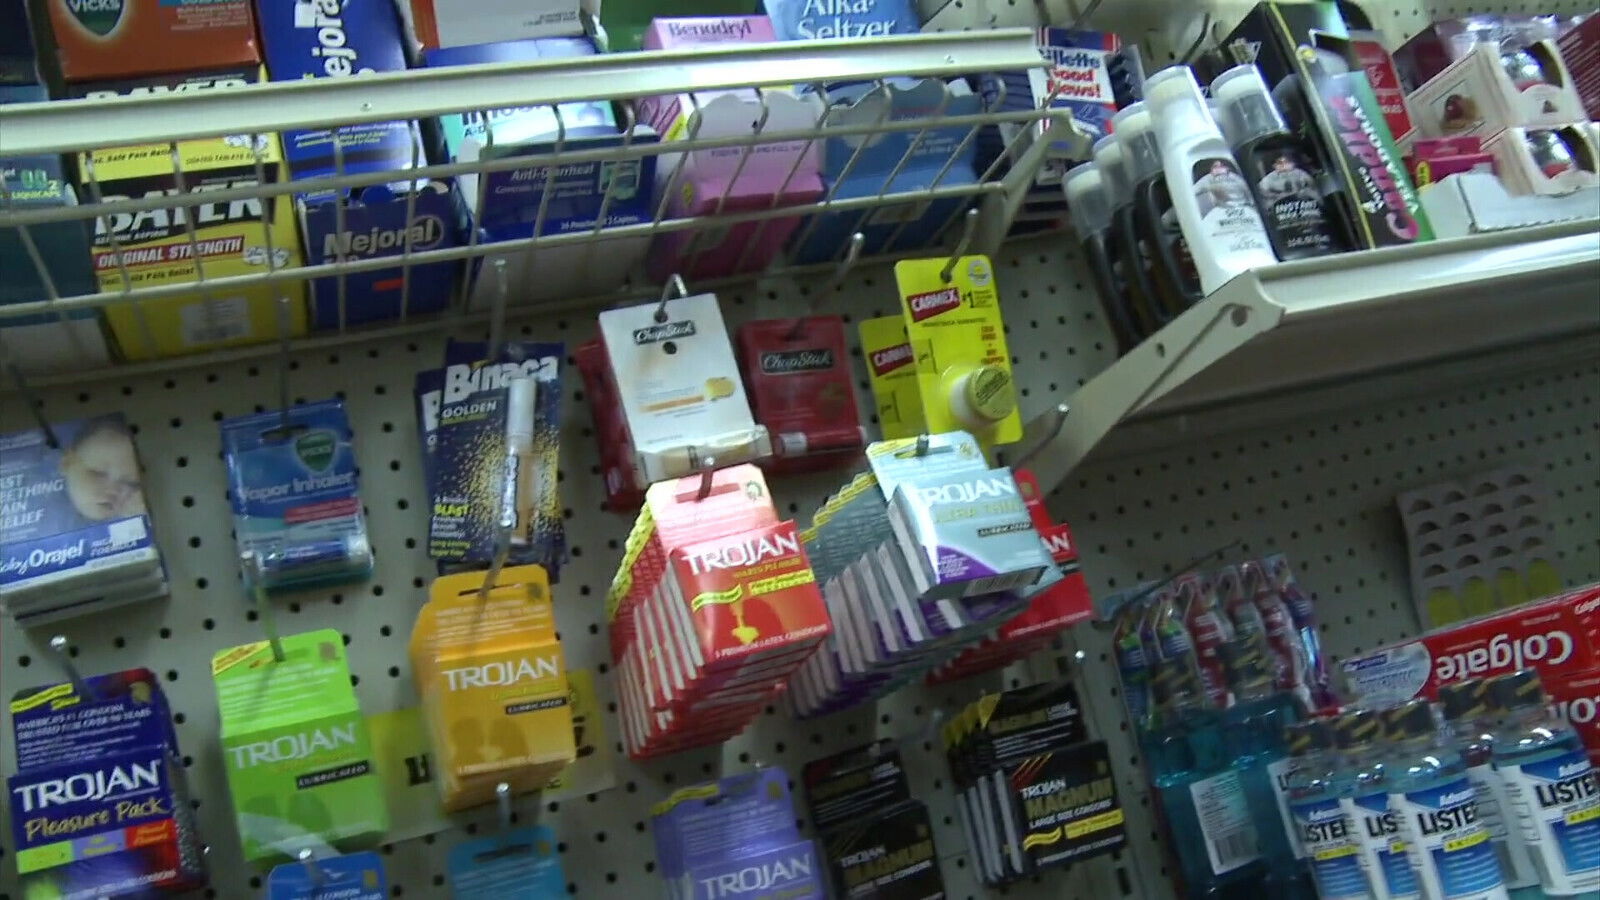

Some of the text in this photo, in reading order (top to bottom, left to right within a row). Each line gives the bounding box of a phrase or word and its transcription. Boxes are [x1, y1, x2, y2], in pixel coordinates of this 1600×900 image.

[311, 0, 357, 77] ejora
[669, 19, 753, 38] Benadryl
[798, 18, 897, 40] Seltzer
[511, 163, 595, 181] Anti-Drrheal
[95, 181, 264, 236] BAYER
[321, 213, 438, 255] Mejoral
[98, 236, 243, 268] ORIGINAL STRENGTH
[636, 323, 694, 343] ChapStick
[764, 354, 831, 371] ChapStick
[444, 356, 558, 404] Binaca
[441, 400, 497, 419] GOLDEN
[0, 474, 24, 490] EST
[292, 472, 356, 492] Inhaler
[0, 503, 28, 518] AIN
[0, 509, 45, 532] ELIEF
[29, 539, 84, 567] Orajel
[681, 530, 800, 576] TROJAN
[1437, 630, 1574, 681] Colgate
[441, 655, 560, 692] TROJAN
[227, 722, 357, 770] TROJAN
[12, 759, 162, 813] TROJAN
[1020, 777, 1067, 799] TROJAN
[25, 808, 110, 842] Pleasure
[115, 797, 170, 822] Pack
[840, 846, 885, 868] TROJAN
[700, 853, 812, 900] TROJAN
